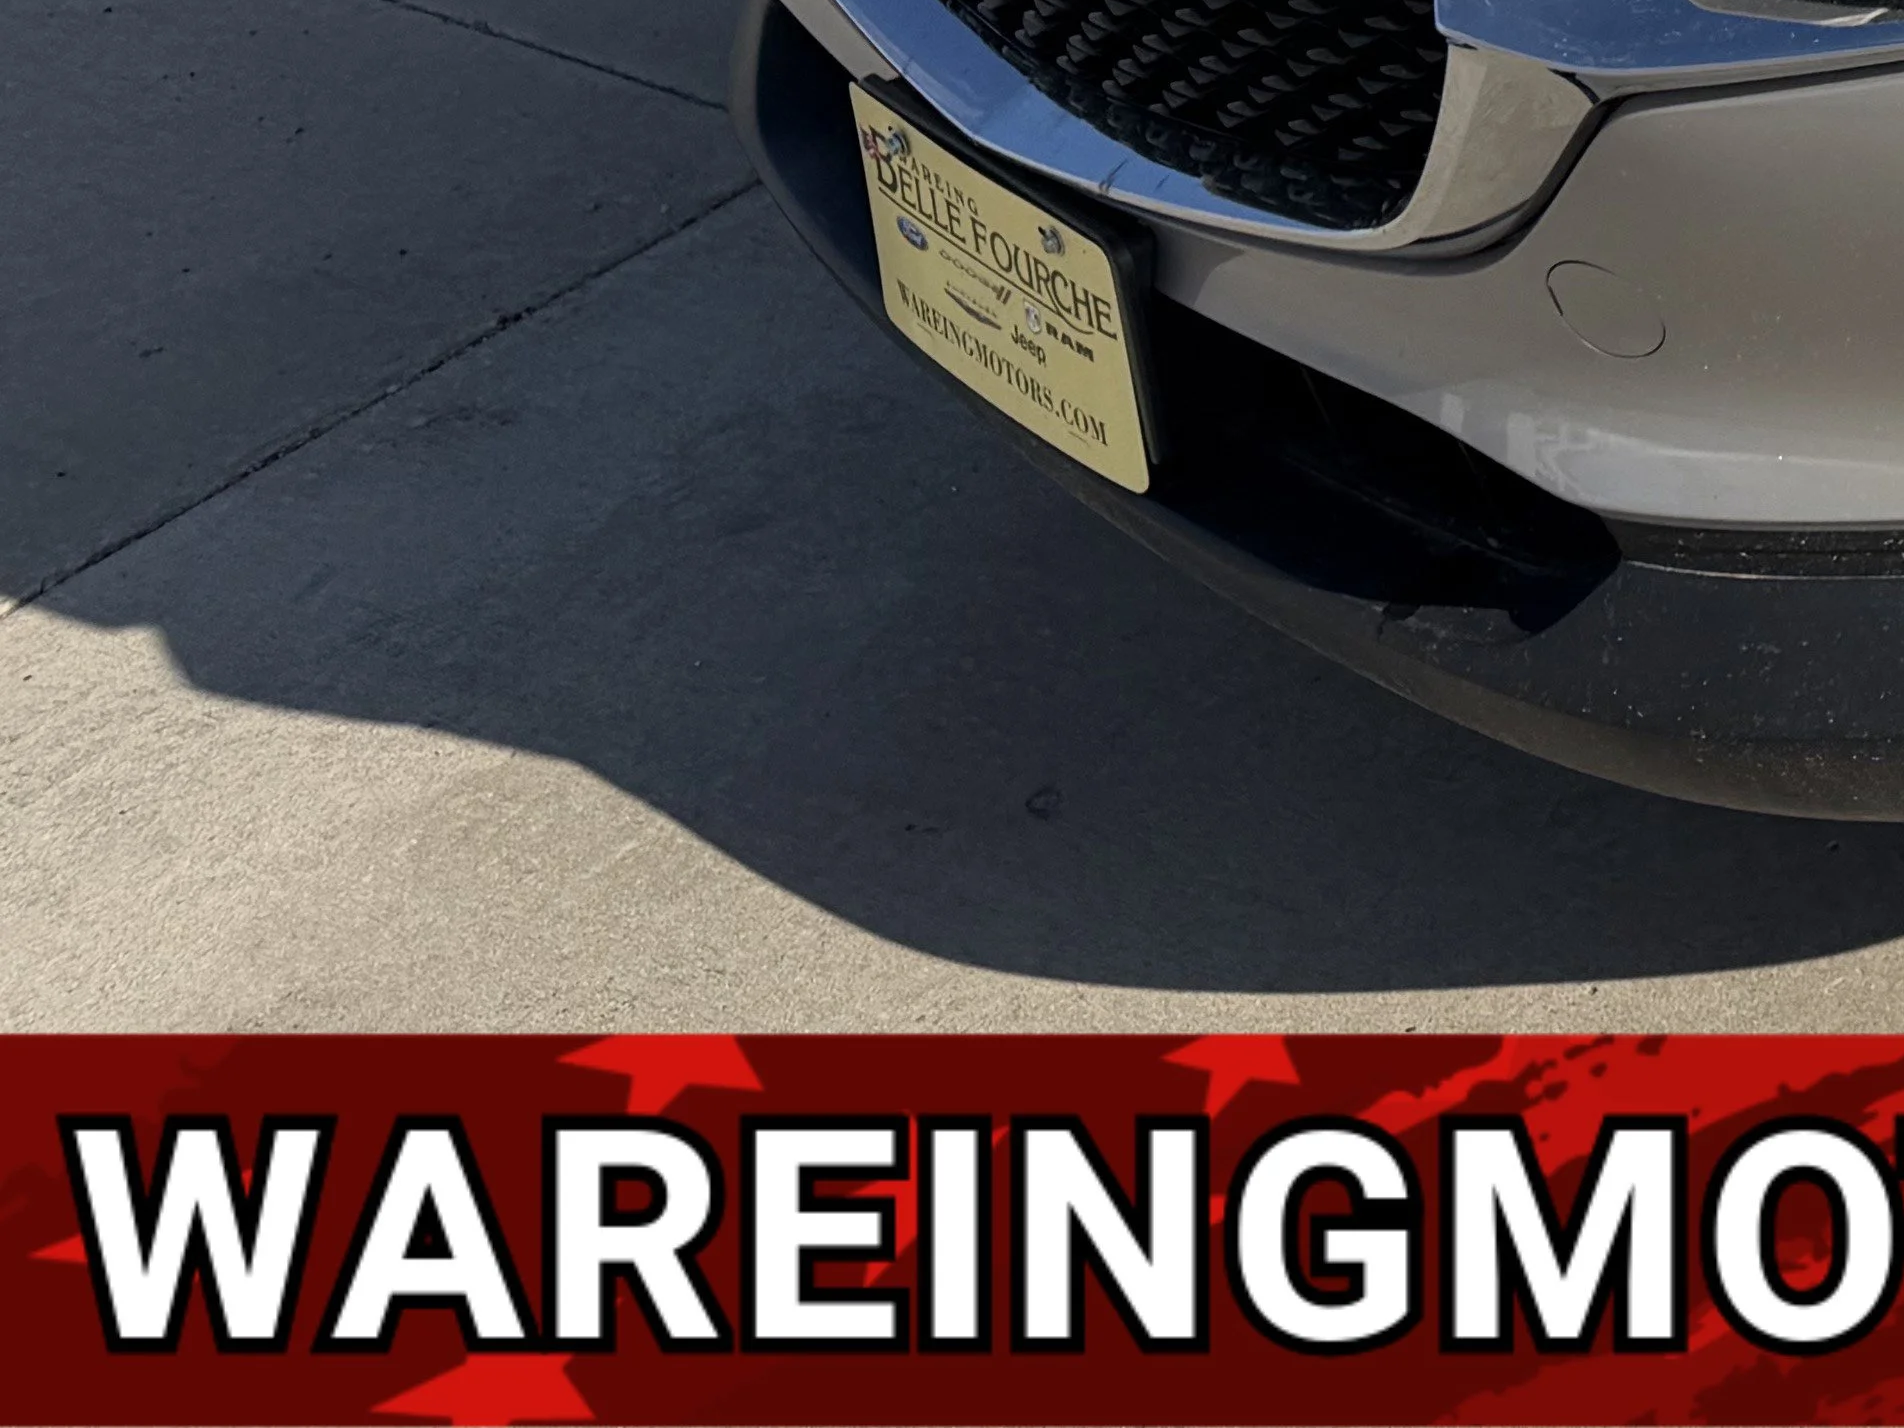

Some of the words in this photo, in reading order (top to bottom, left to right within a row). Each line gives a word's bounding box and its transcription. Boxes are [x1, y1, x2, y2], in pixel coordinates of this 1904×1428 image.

[868, 124, 967, 245] BELLE
[970, 215, 1118, 341] FOURCHE
[897, 278, 1109, 447] WAREINGMOTORS.COM
[1011, 324, 1047, 368] Jeep
[1045, 321, 1095, 363] RAM
